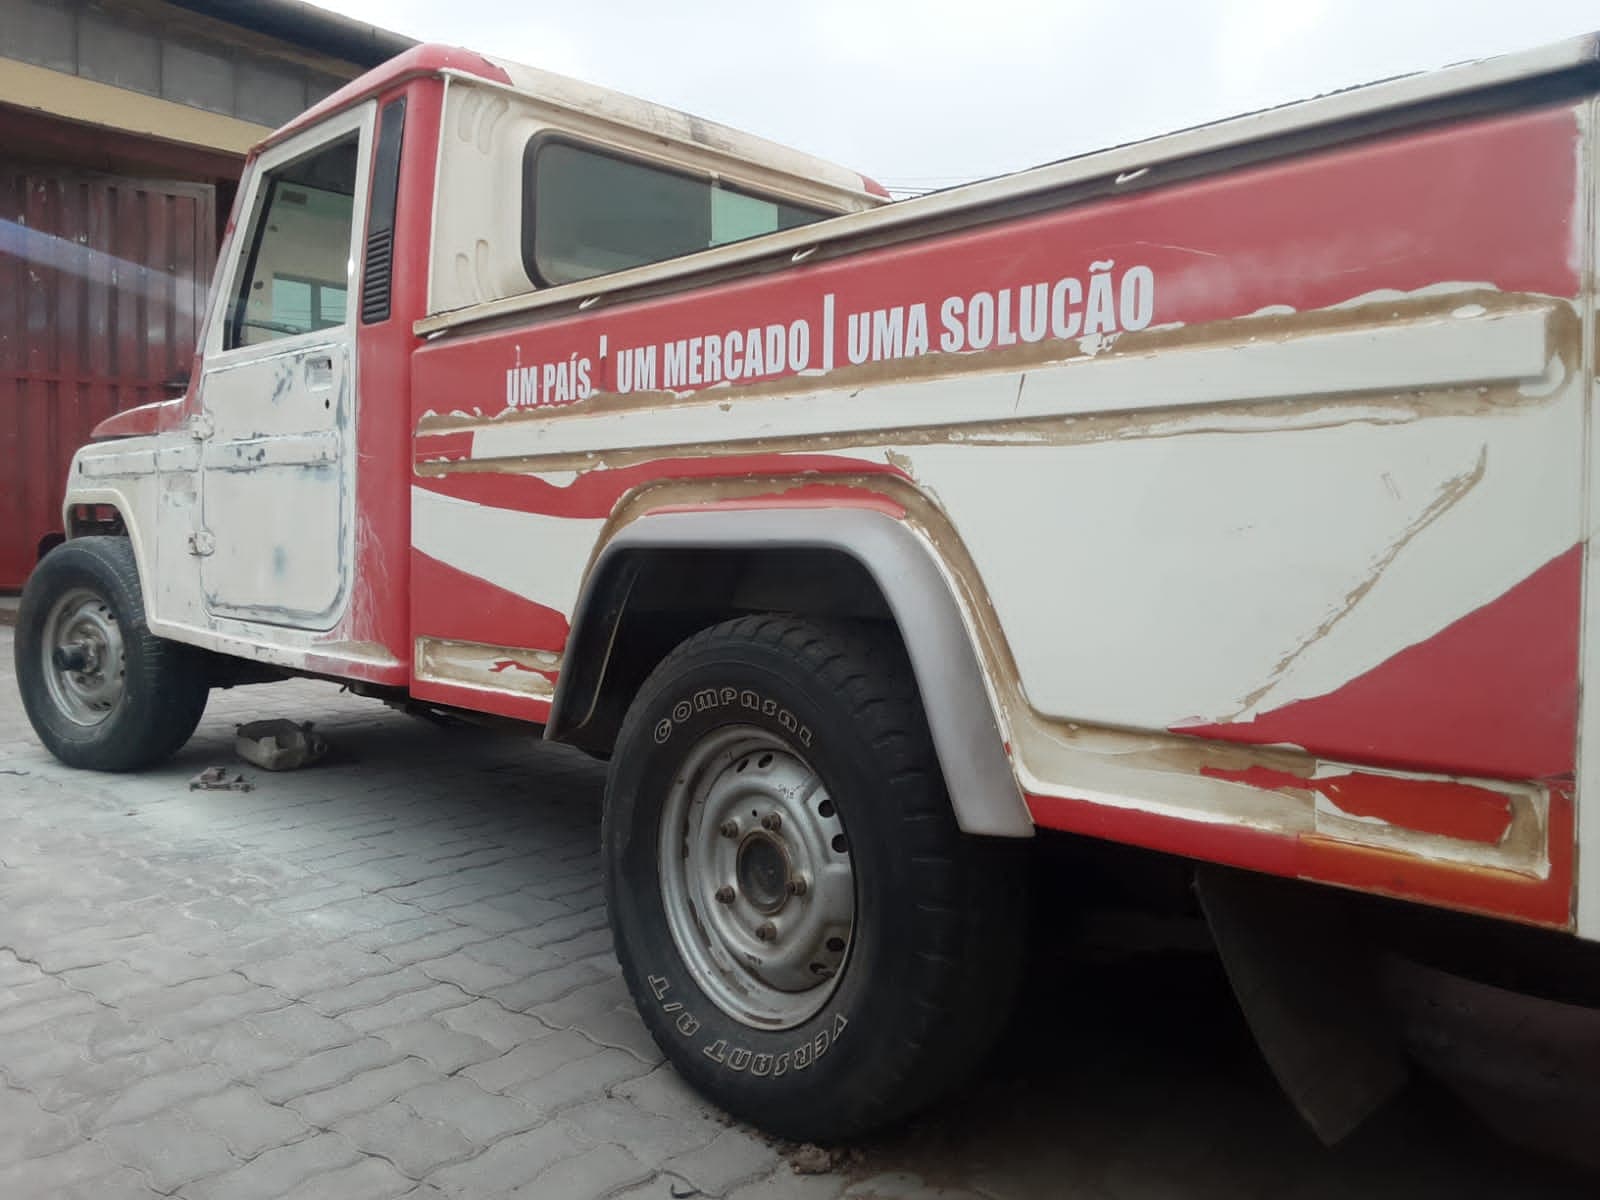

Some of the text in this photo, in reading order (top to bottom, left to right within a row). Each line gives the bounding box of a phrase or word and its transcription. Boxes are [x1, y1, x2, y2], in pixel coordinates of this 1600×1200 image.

[506, 366, 538, 407] UM
[543, 351, 592, 404] PAÍS
[617, 344, 657, 394] UM
[664, 319, 810, 388] MERCADO
[848, 303, 929, 365] UMA
[647, 974, 849, 1077] VERSANT A/T
